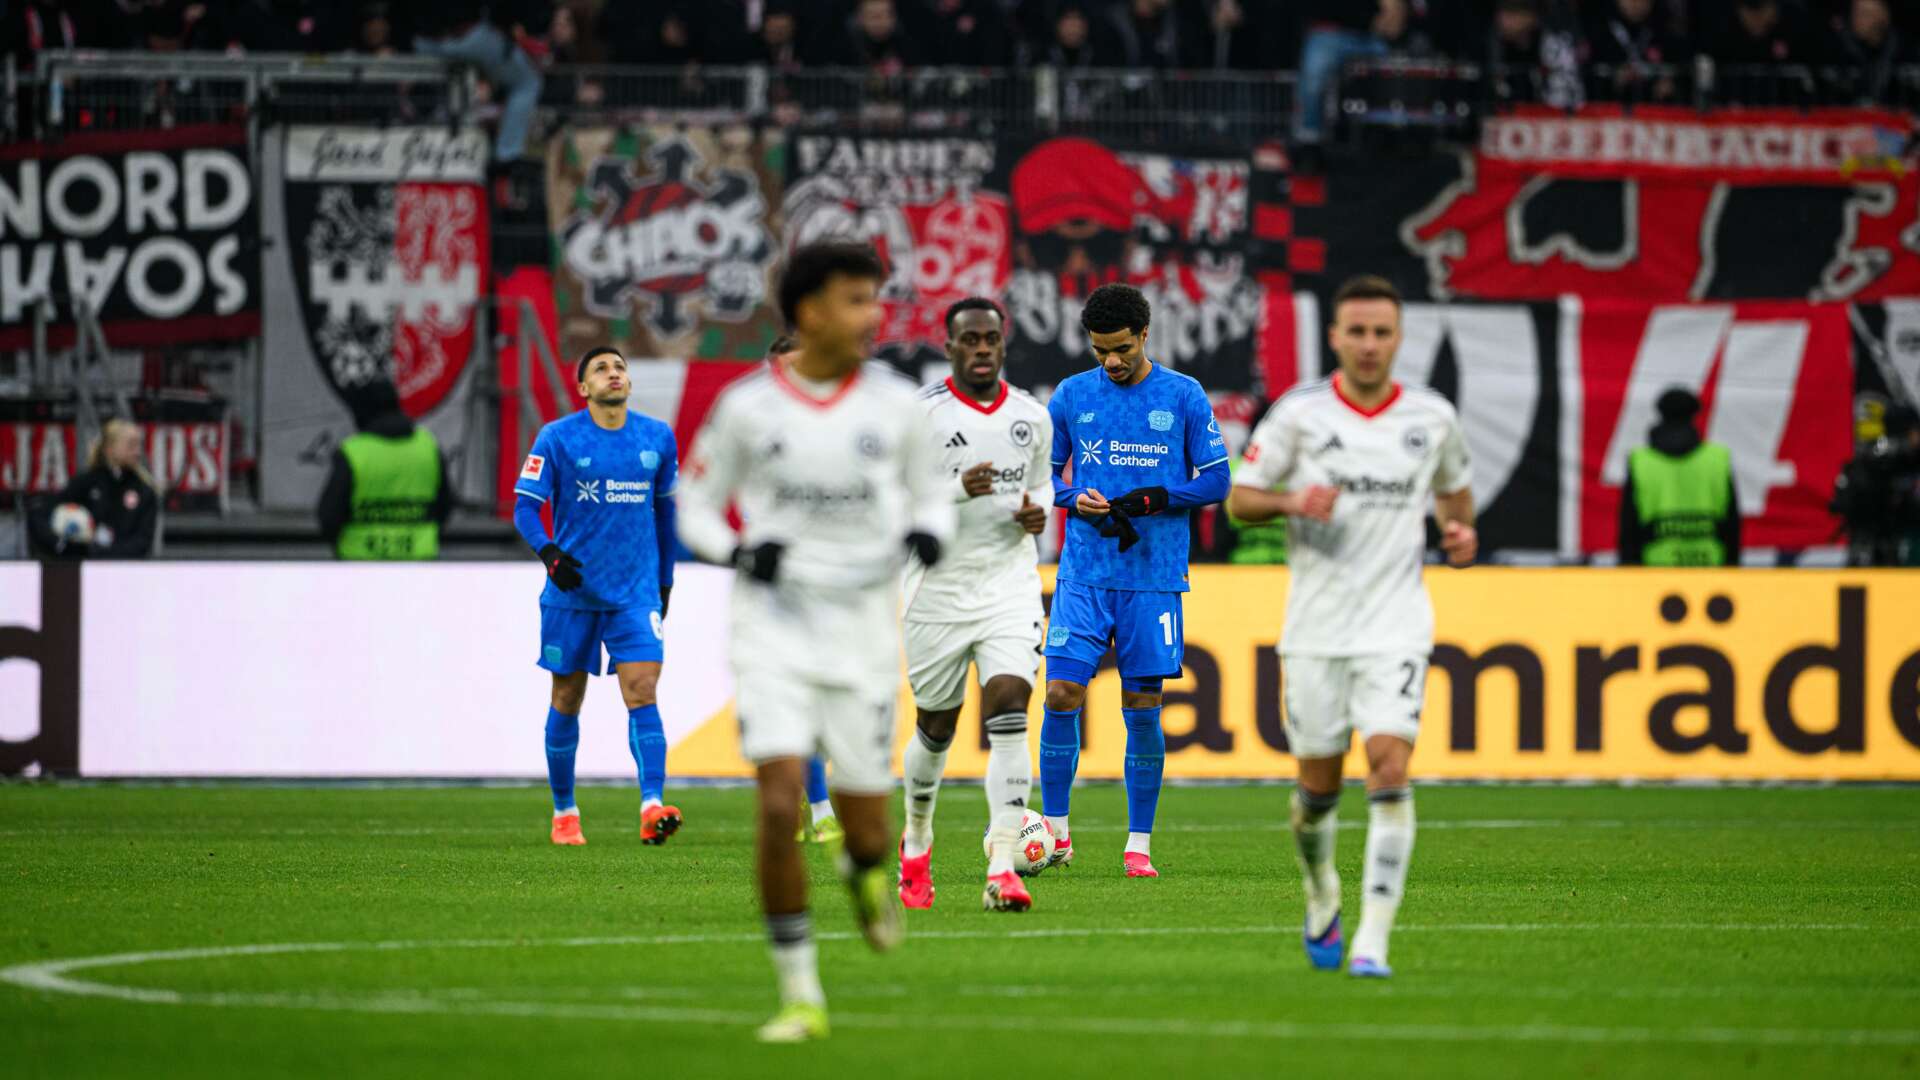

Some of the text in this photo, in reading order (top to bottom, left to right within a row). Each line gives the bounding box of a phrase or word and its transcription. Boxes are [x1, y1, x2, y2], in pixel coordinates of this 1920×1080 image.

[0, 150, 250, 239] NORD
[1110, 440, 1169, 454] Barmenia
[1109, 454, 1160, 467] Gothaer
[1158, 612, 1177, 646] 1
